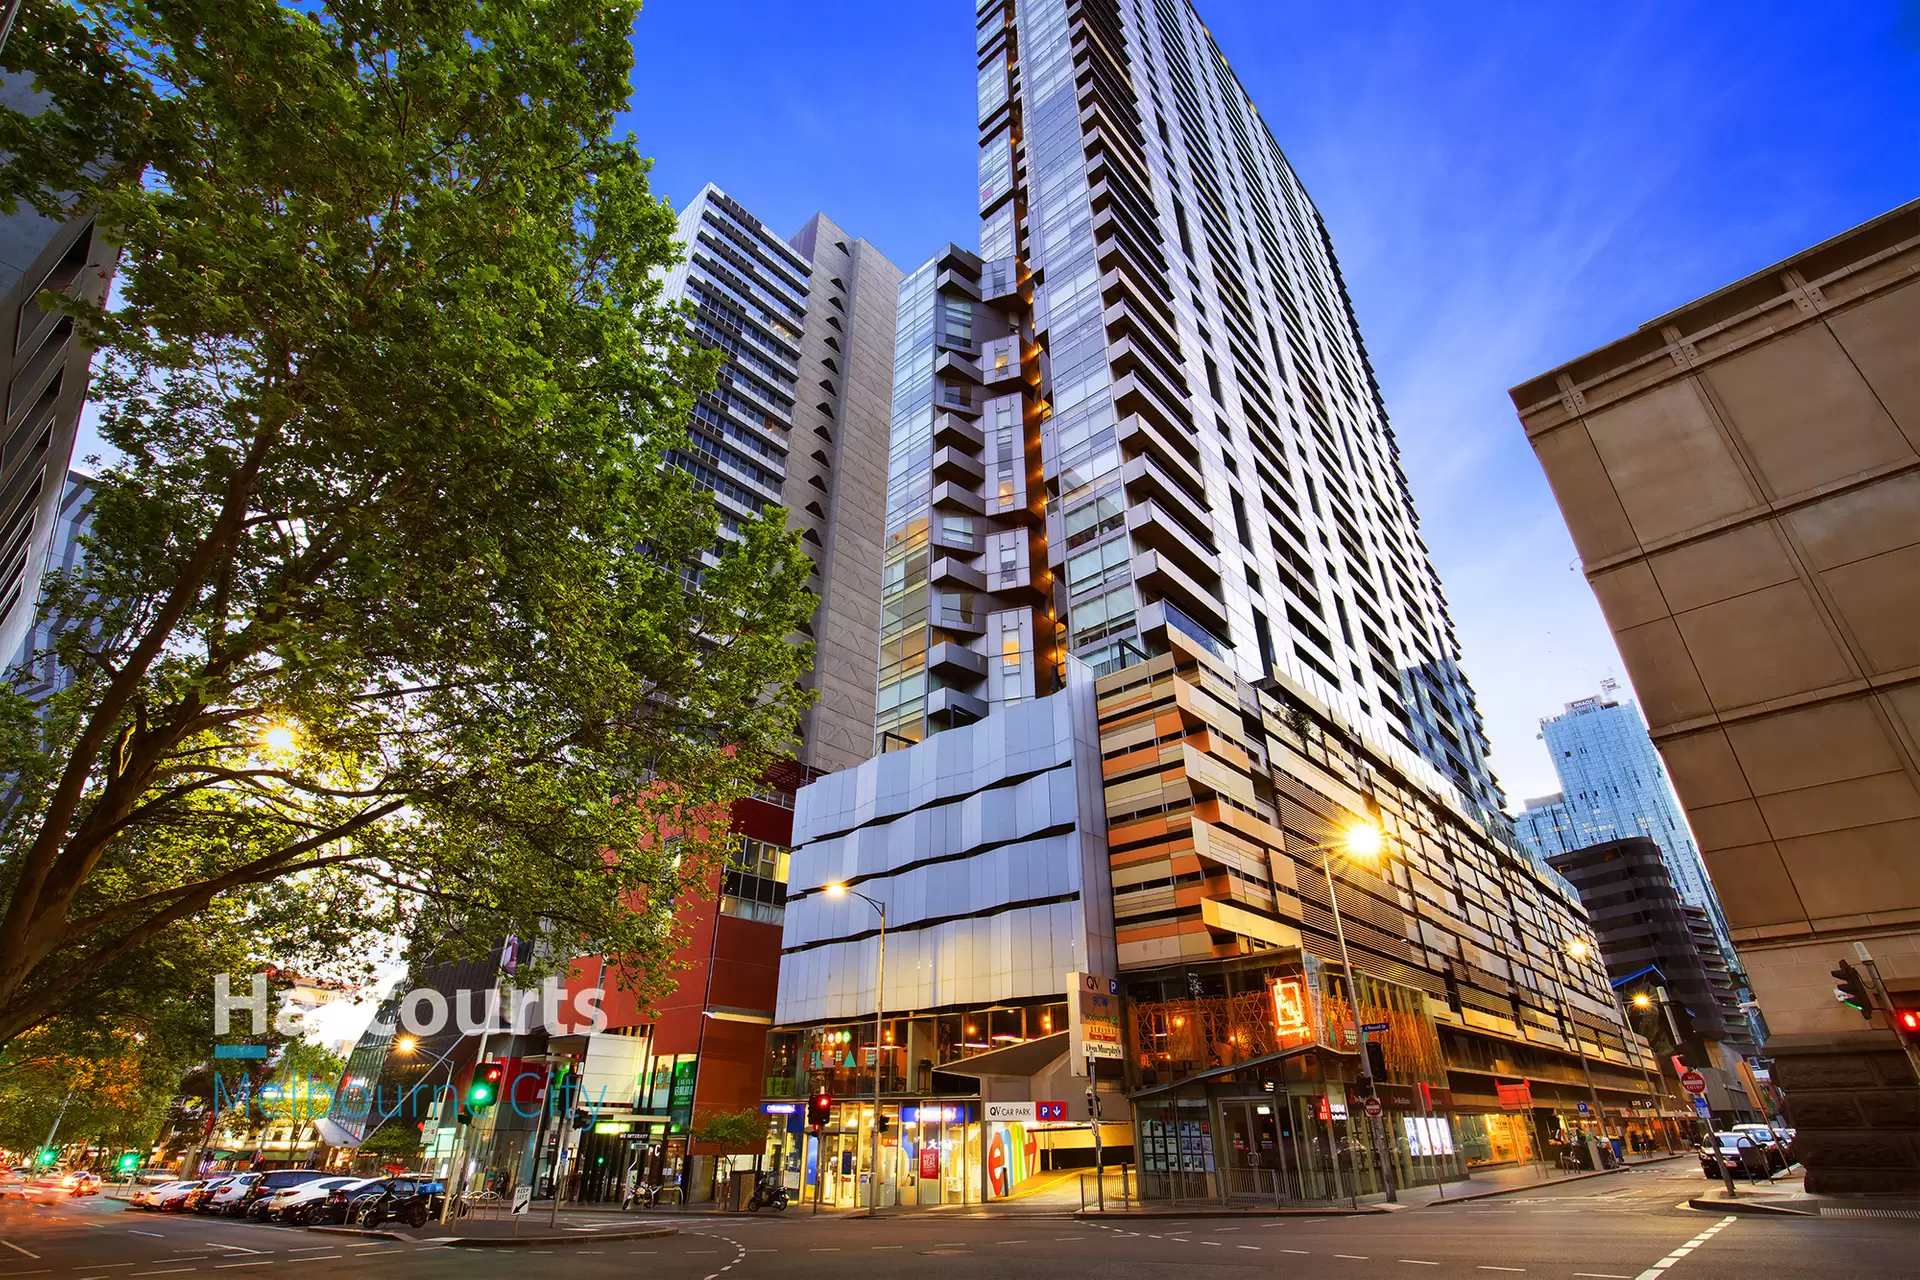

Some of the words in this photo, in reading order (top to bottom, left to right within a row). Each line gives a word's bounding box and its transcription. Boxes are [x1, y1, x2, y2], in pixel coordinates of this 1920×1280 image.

[1086, 975, 1100, 990] QV
[989, 1106, 1001, 1116] QV
[1001, 1108, 1014, 1116] CAR
[1015, 1108, 1031, 1116] PARK
